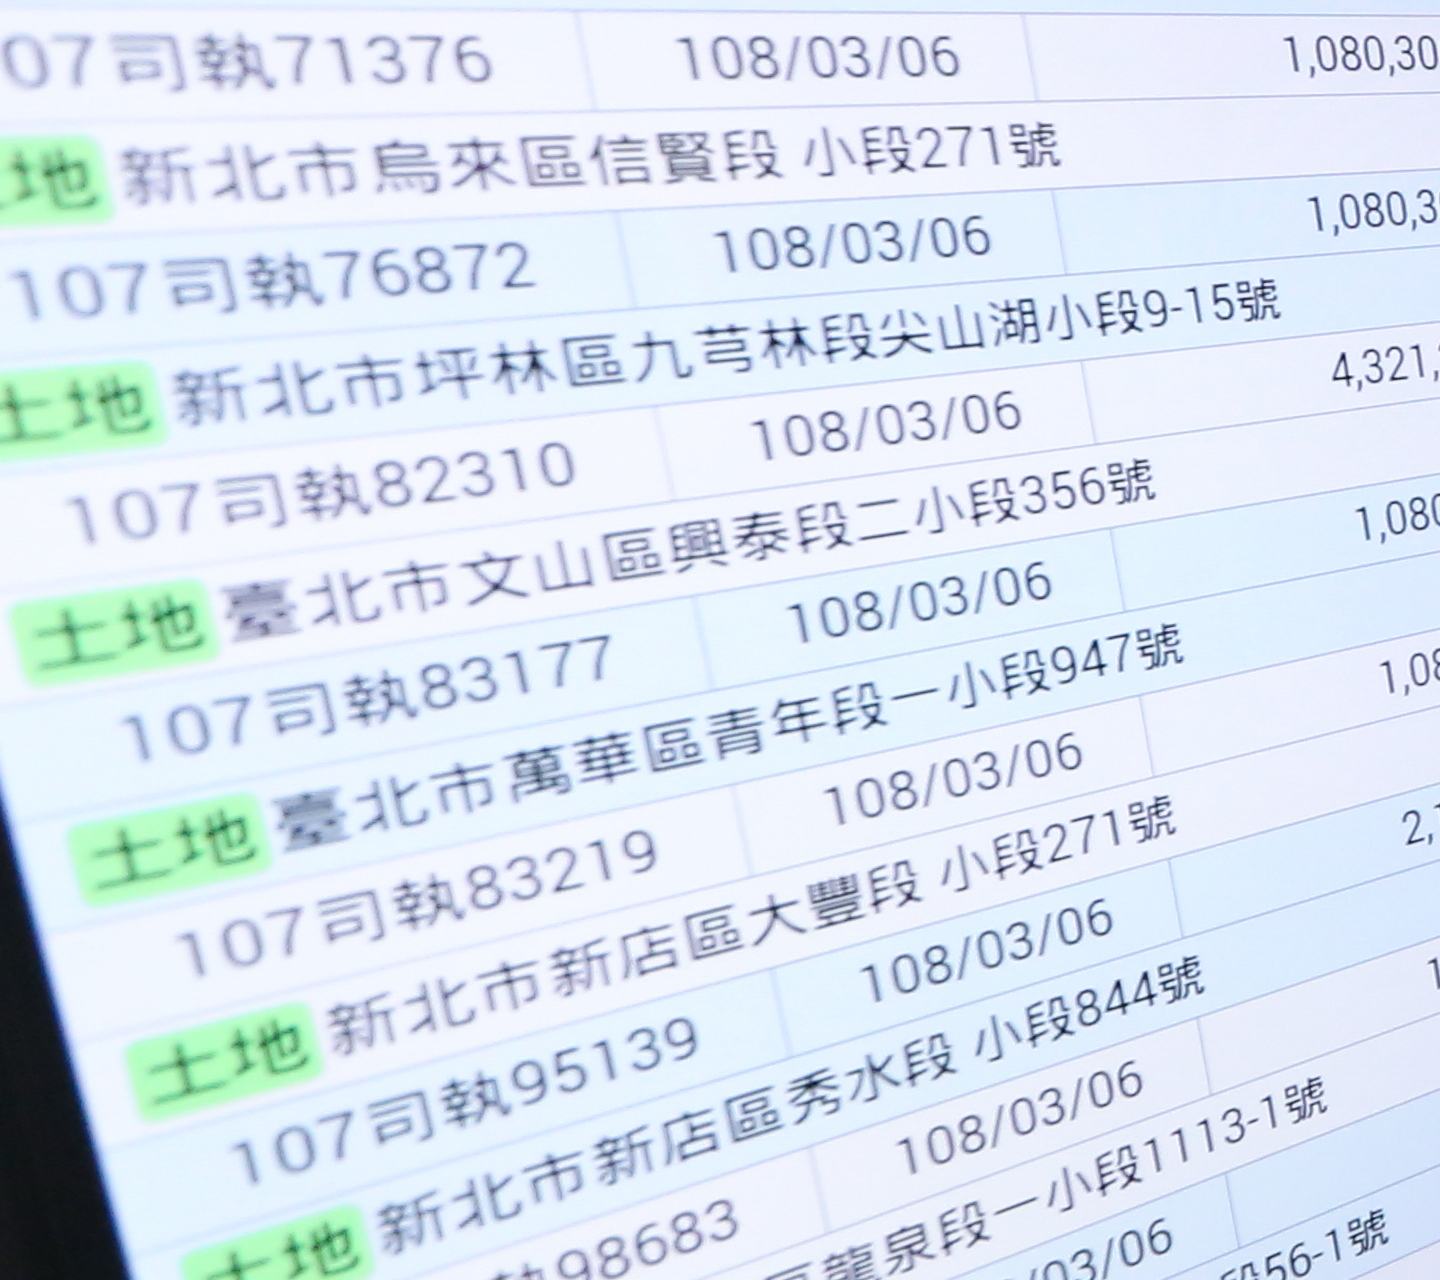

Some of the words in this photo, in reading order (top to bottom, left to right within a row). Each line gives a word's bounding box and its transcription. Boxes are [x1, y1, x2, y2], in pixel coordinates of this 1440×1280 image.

[2, 29, 493, 94] 07司執71376
[675, 32, 962, 83] 108/03/06
[119, 127, 783, 207] 新北市烏來區信賢段
[805, 122, 1062, 175] 小段271號
[11, 240, 538, 321] 107司執76872
[713, 215, 991, 274] 108/03/06
[172, 276, 1282, 428] 新北市坪林區九芎林段尖山湖小段9-15號
[752, 389, 1024, 462] 108/03/06
[65, 441, 577, 547] 107司執82310
[221, 456, 1158, 644] 臺北市文山區興泰段二小段356號
[34, 593, 204, 671] 土地
[785, 561, 1054, 645] 108/03/06
[120, 634, 614, 764] 107司執83177
[274, 621, 1187, 854] 臺北市萬華區青年段一小段947號
[825, 730, 1083, 828] 108/03/06
[88, 792, 259, 892] 土地
[176, 828, 660, 980] 107司執83219
[326, 857, 925, 1060] 新北市新店區大豐段
[940, 793, 1179, 897] 小段271號
[860, 896, 1115, 1005] 108/03/06
[146, 1019, 312, 1107] 土地
[230, 1015, 702, 1188] 107司執95139
[376, 1030, 960, 1258] 新北市新店區秀水段
[973, 952, 1208, 1069] 小段844號
[895, 1059, 1146, 1178] 108/03/06
